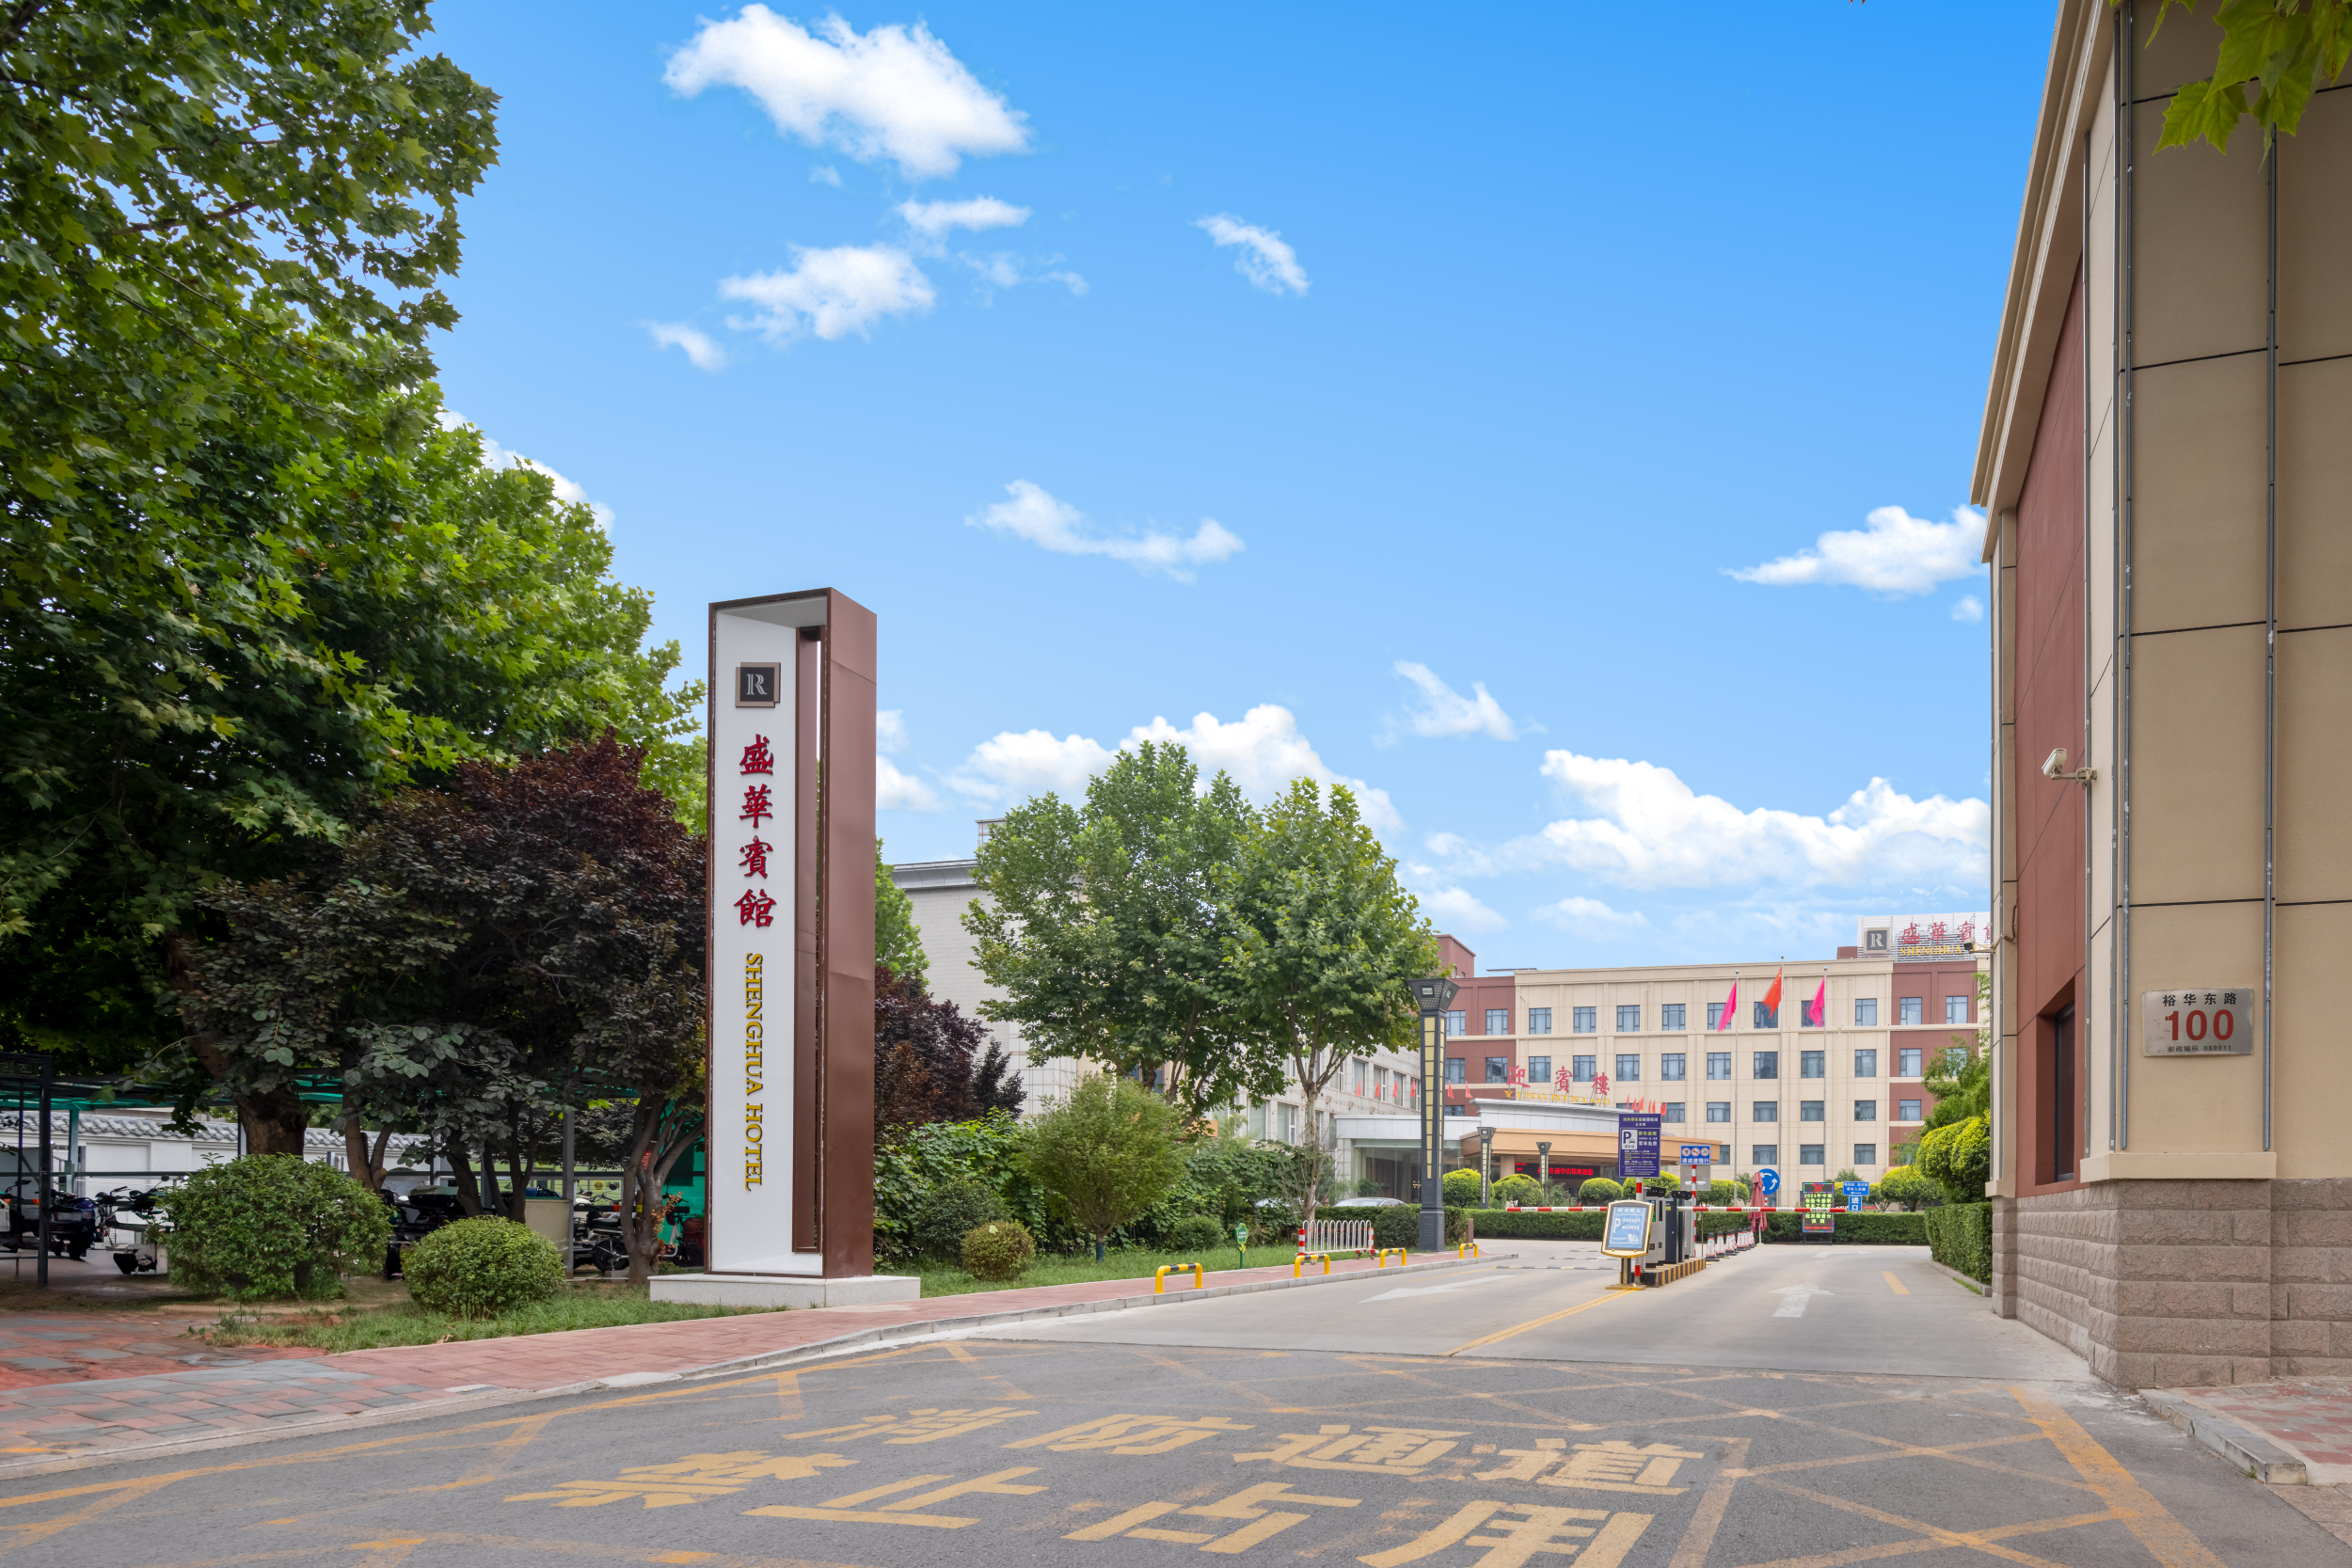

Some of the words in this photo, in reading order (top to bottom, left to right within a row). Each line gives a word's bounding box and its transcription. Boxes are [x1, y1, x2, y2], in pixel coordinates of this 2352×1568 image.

[746, 673, 768, 695] R
[734, 734, 777, 927] 盛華賓館
[1870, 933, 1883, 947] R
[1900, 921, 1990, 944] 盛華賓
[1900, 944, 1963, 956] SHENGHUA
[2162, 992, 2237, 1006] 裕华东路
[745, 952, 763, 1096] SHENGHUA
[2165, 1009, 2233, 1040] 100
[1505, 1065, 1611, 1096] 迎賓樓
[1503, 1090, 1611, 1105] YINGBINLOU
[745, 1103, 763, 1191] HOTEL
[1537, 1167, 1594, 1176] 庄盛华宾馆欢迎您
[762, 1407, 1705, 1496] 消防通道
[503, 1449, 1654, 1568] 禁止占用
